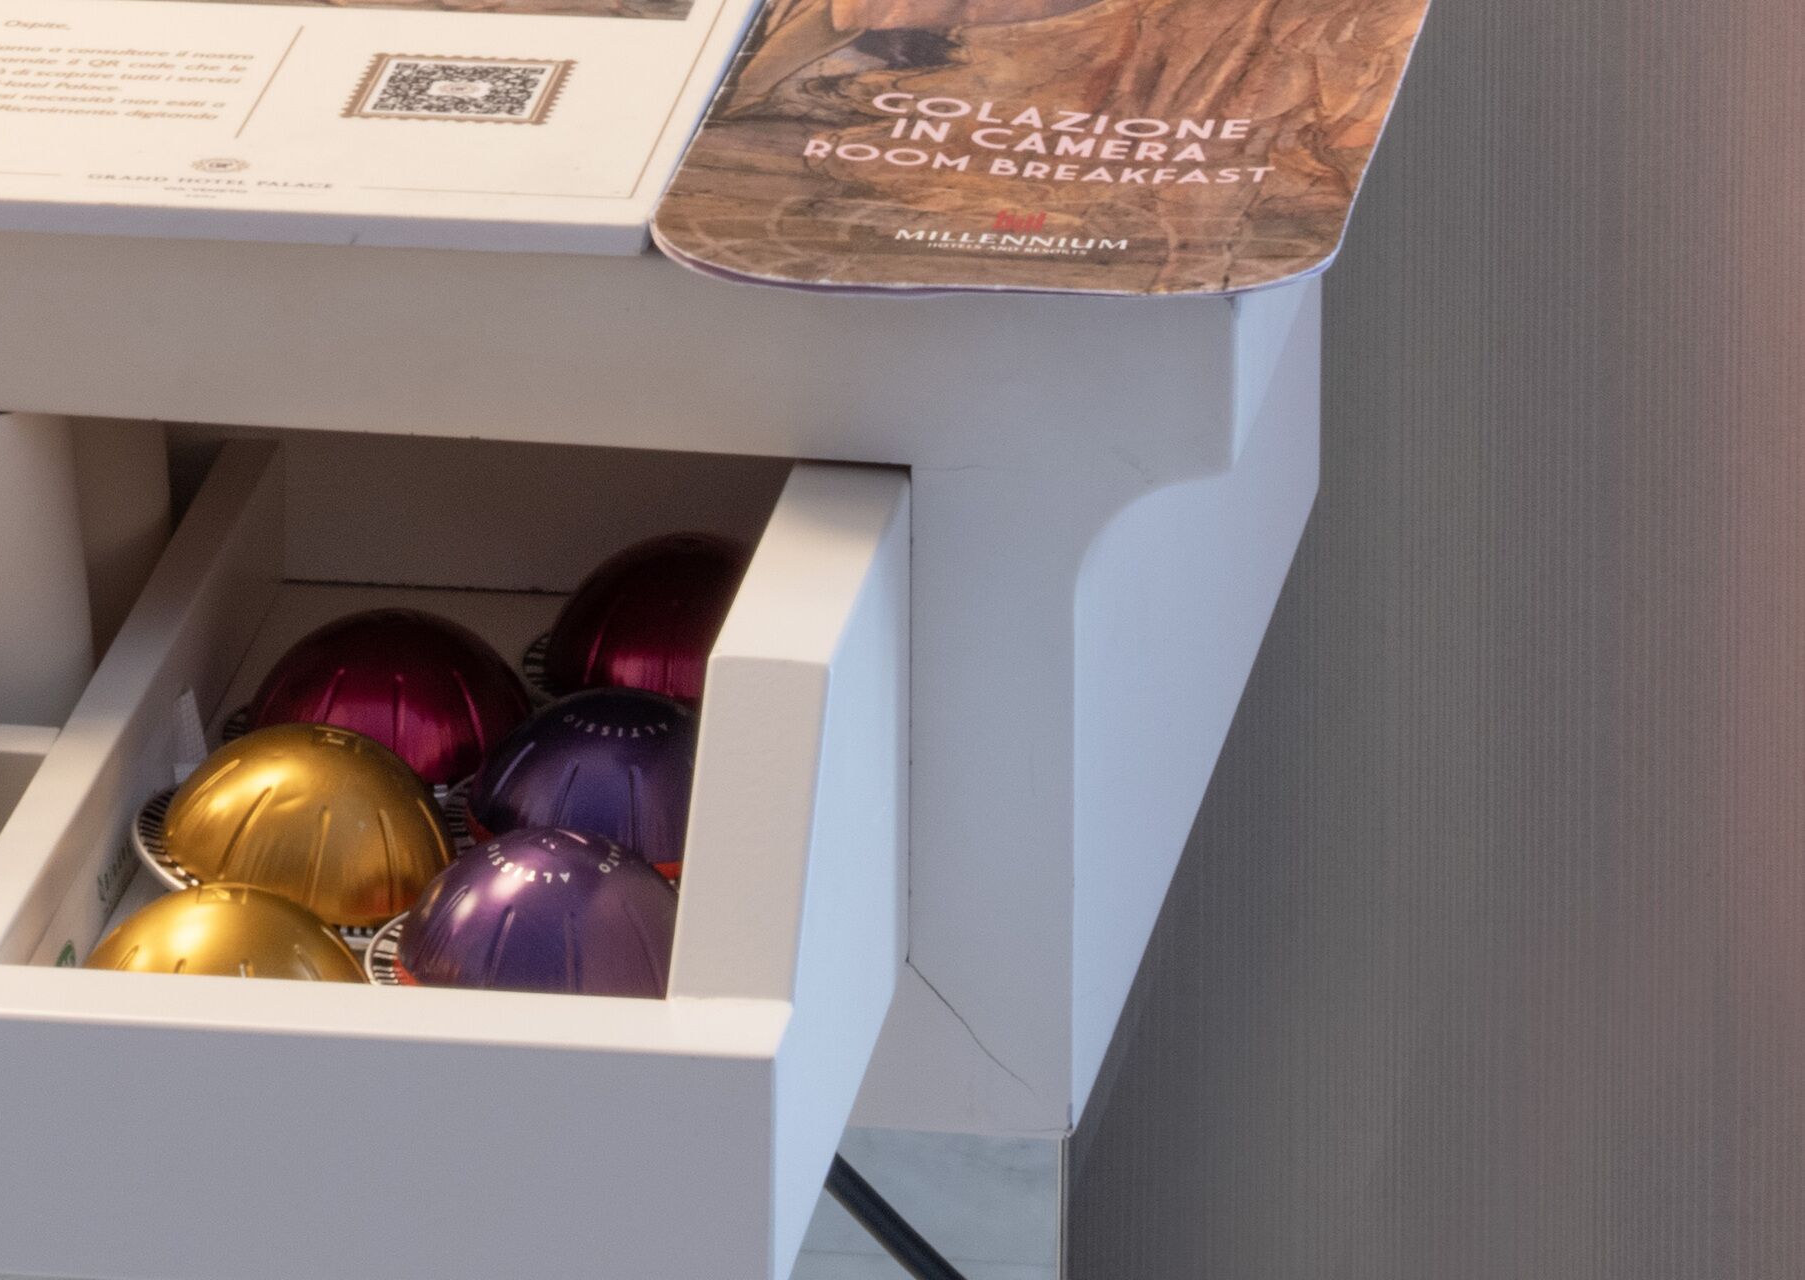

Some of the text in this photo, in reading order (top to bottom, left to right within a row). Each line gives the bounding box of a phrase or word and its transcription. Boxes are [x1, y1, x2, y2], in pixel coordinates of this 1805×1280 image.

[88, 58, 121, 69] QR
[871, 92, 1252, 140] COLAZIONE
[889, 118, 1207, 163] IN CAMERA
[802, 139, 1276, 185] ROOM BREAKFAST
[87, 172, 334, 189] GRAND HOTEL PALACE
[894, 228, 1128, 250] MILLENNIUM
[926, 242, 1088, 256] HOTELS AND RESORTS
[562, 714, 669, 739] ALTISSIO
[487, 843, 571, 884] ALTISSIO
